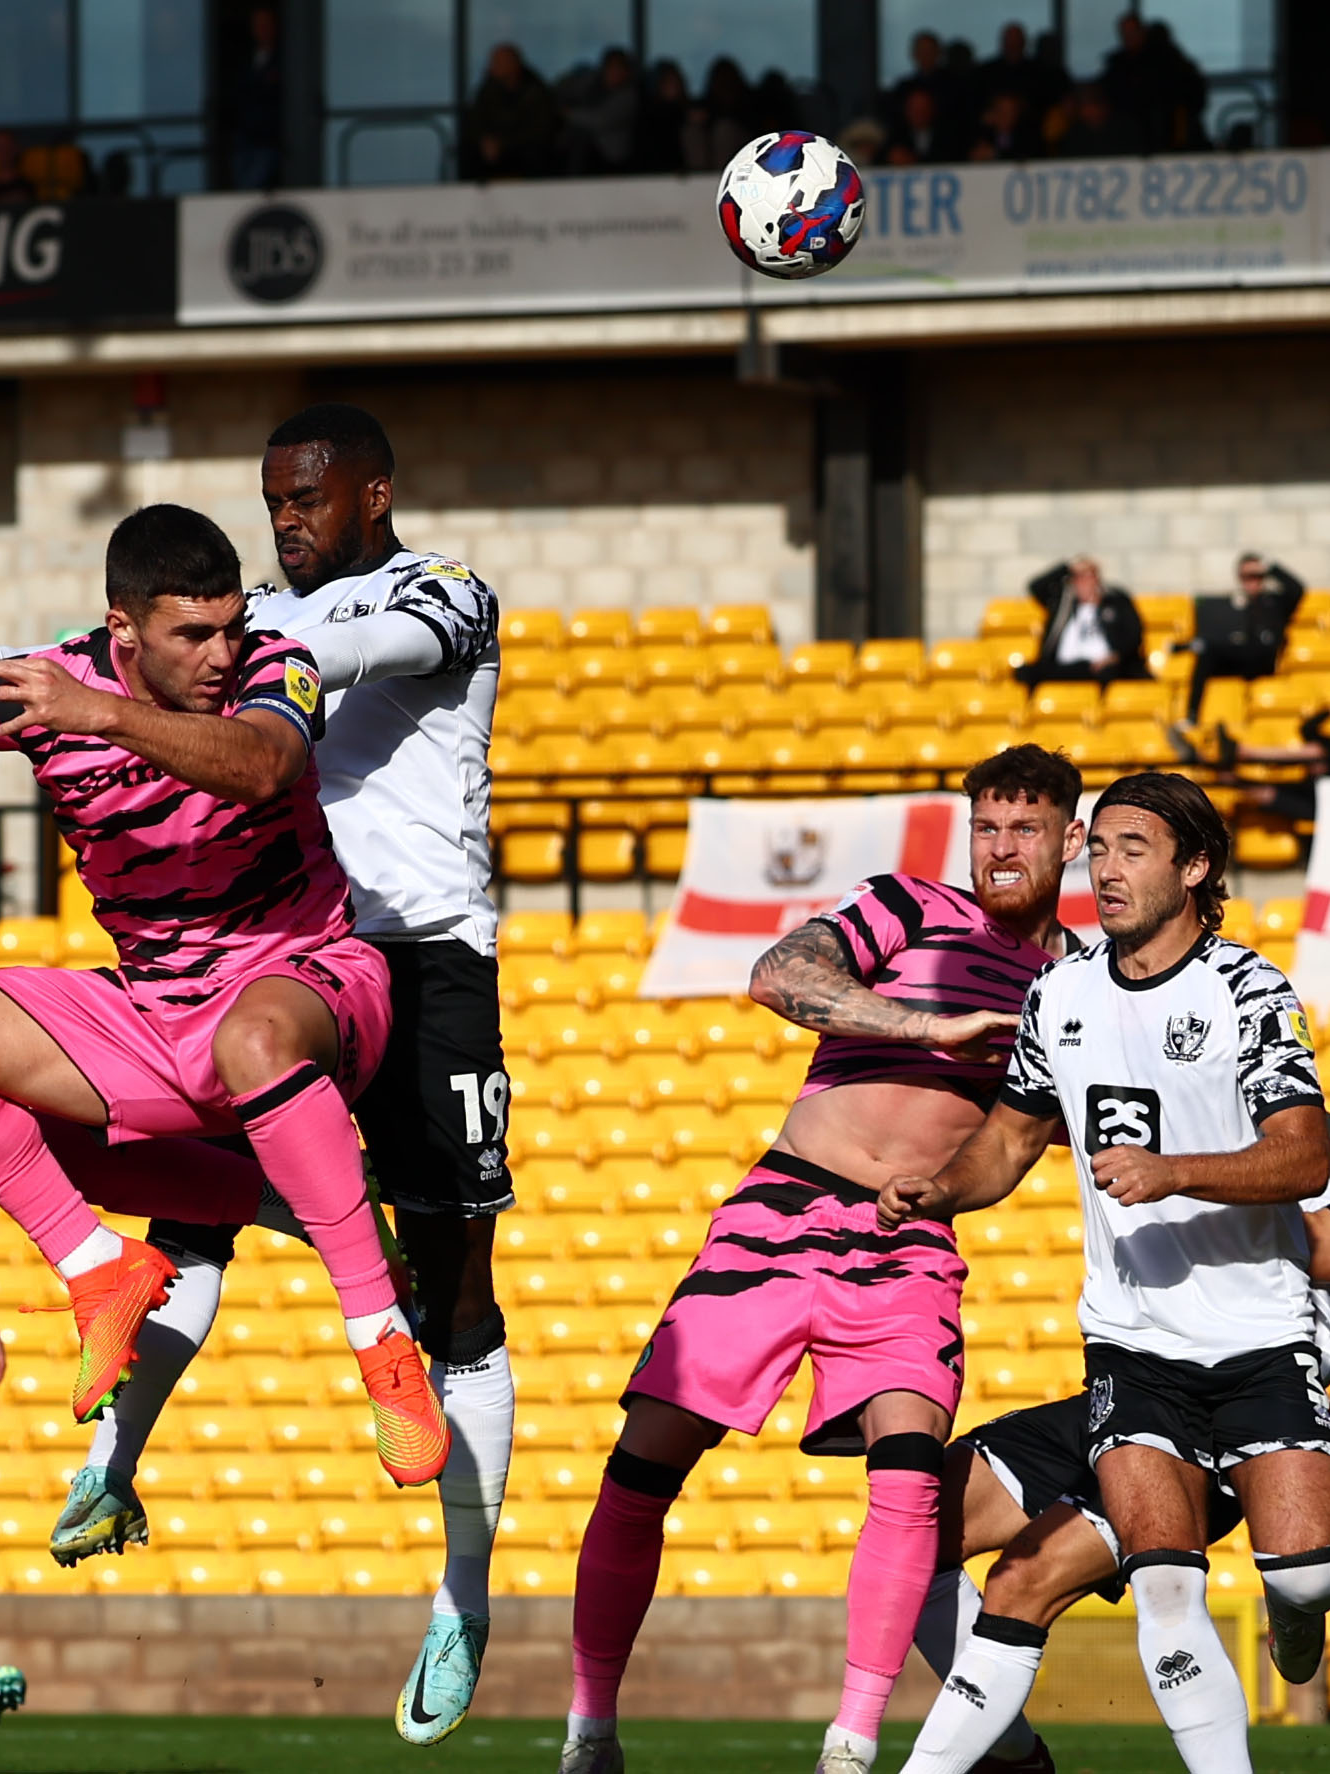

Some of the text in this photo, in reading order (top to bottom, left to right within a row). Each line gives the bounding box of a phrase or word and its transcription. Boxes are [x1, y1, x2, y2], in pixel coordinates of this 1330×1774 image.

[863, 171, 964, 237] TER
[1004, 158, 1307, 224] 01782 822250
[450, 1071, 510, 1144] 19
